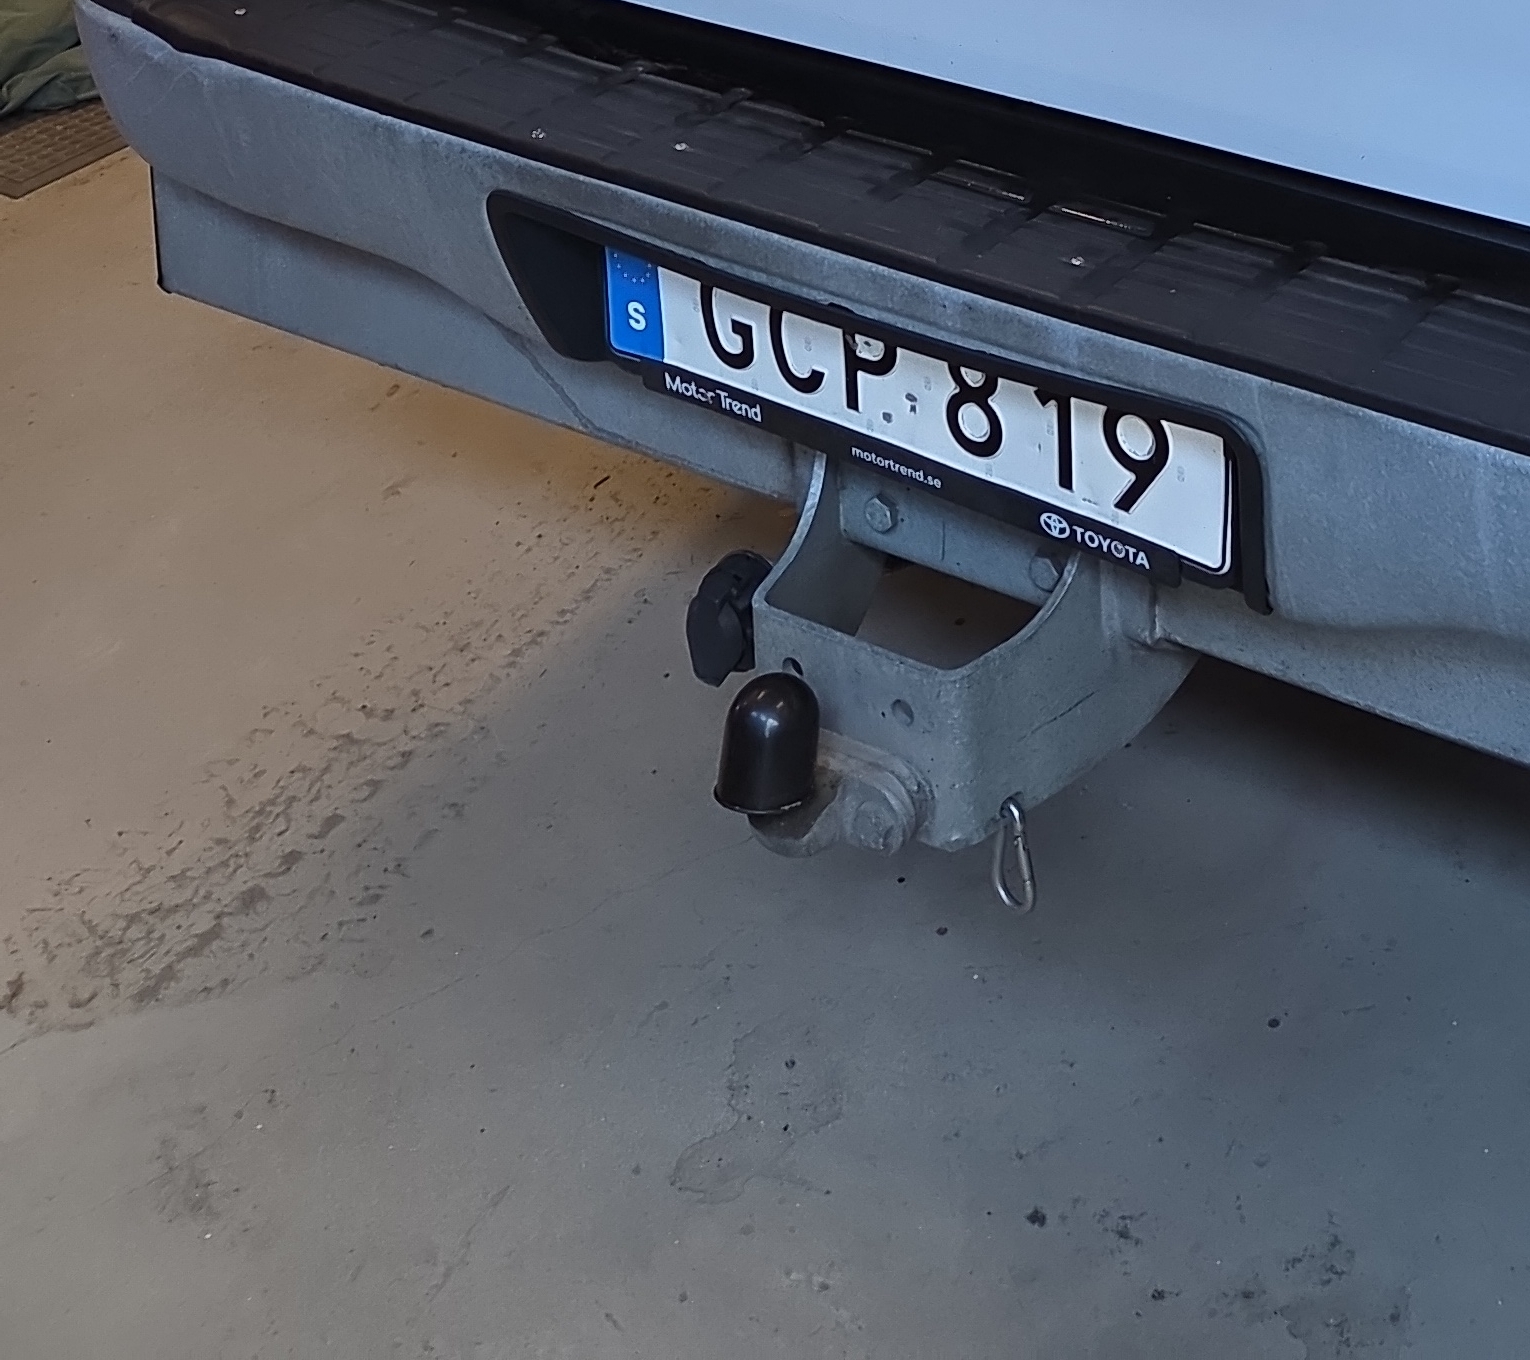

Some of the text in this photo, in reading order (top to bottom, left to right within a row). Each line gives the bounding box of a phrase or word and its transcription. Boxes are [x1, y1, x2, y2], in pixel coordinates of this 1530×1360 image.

[627, 300, 648, 333] S
[664, 371, 764, 424] Motor Trend
[698, 280, 1172, 515] GCP 819
[850, 444, 943, 490] motortrend.se
[1071, 524, 1151, 571] TOYOTA
